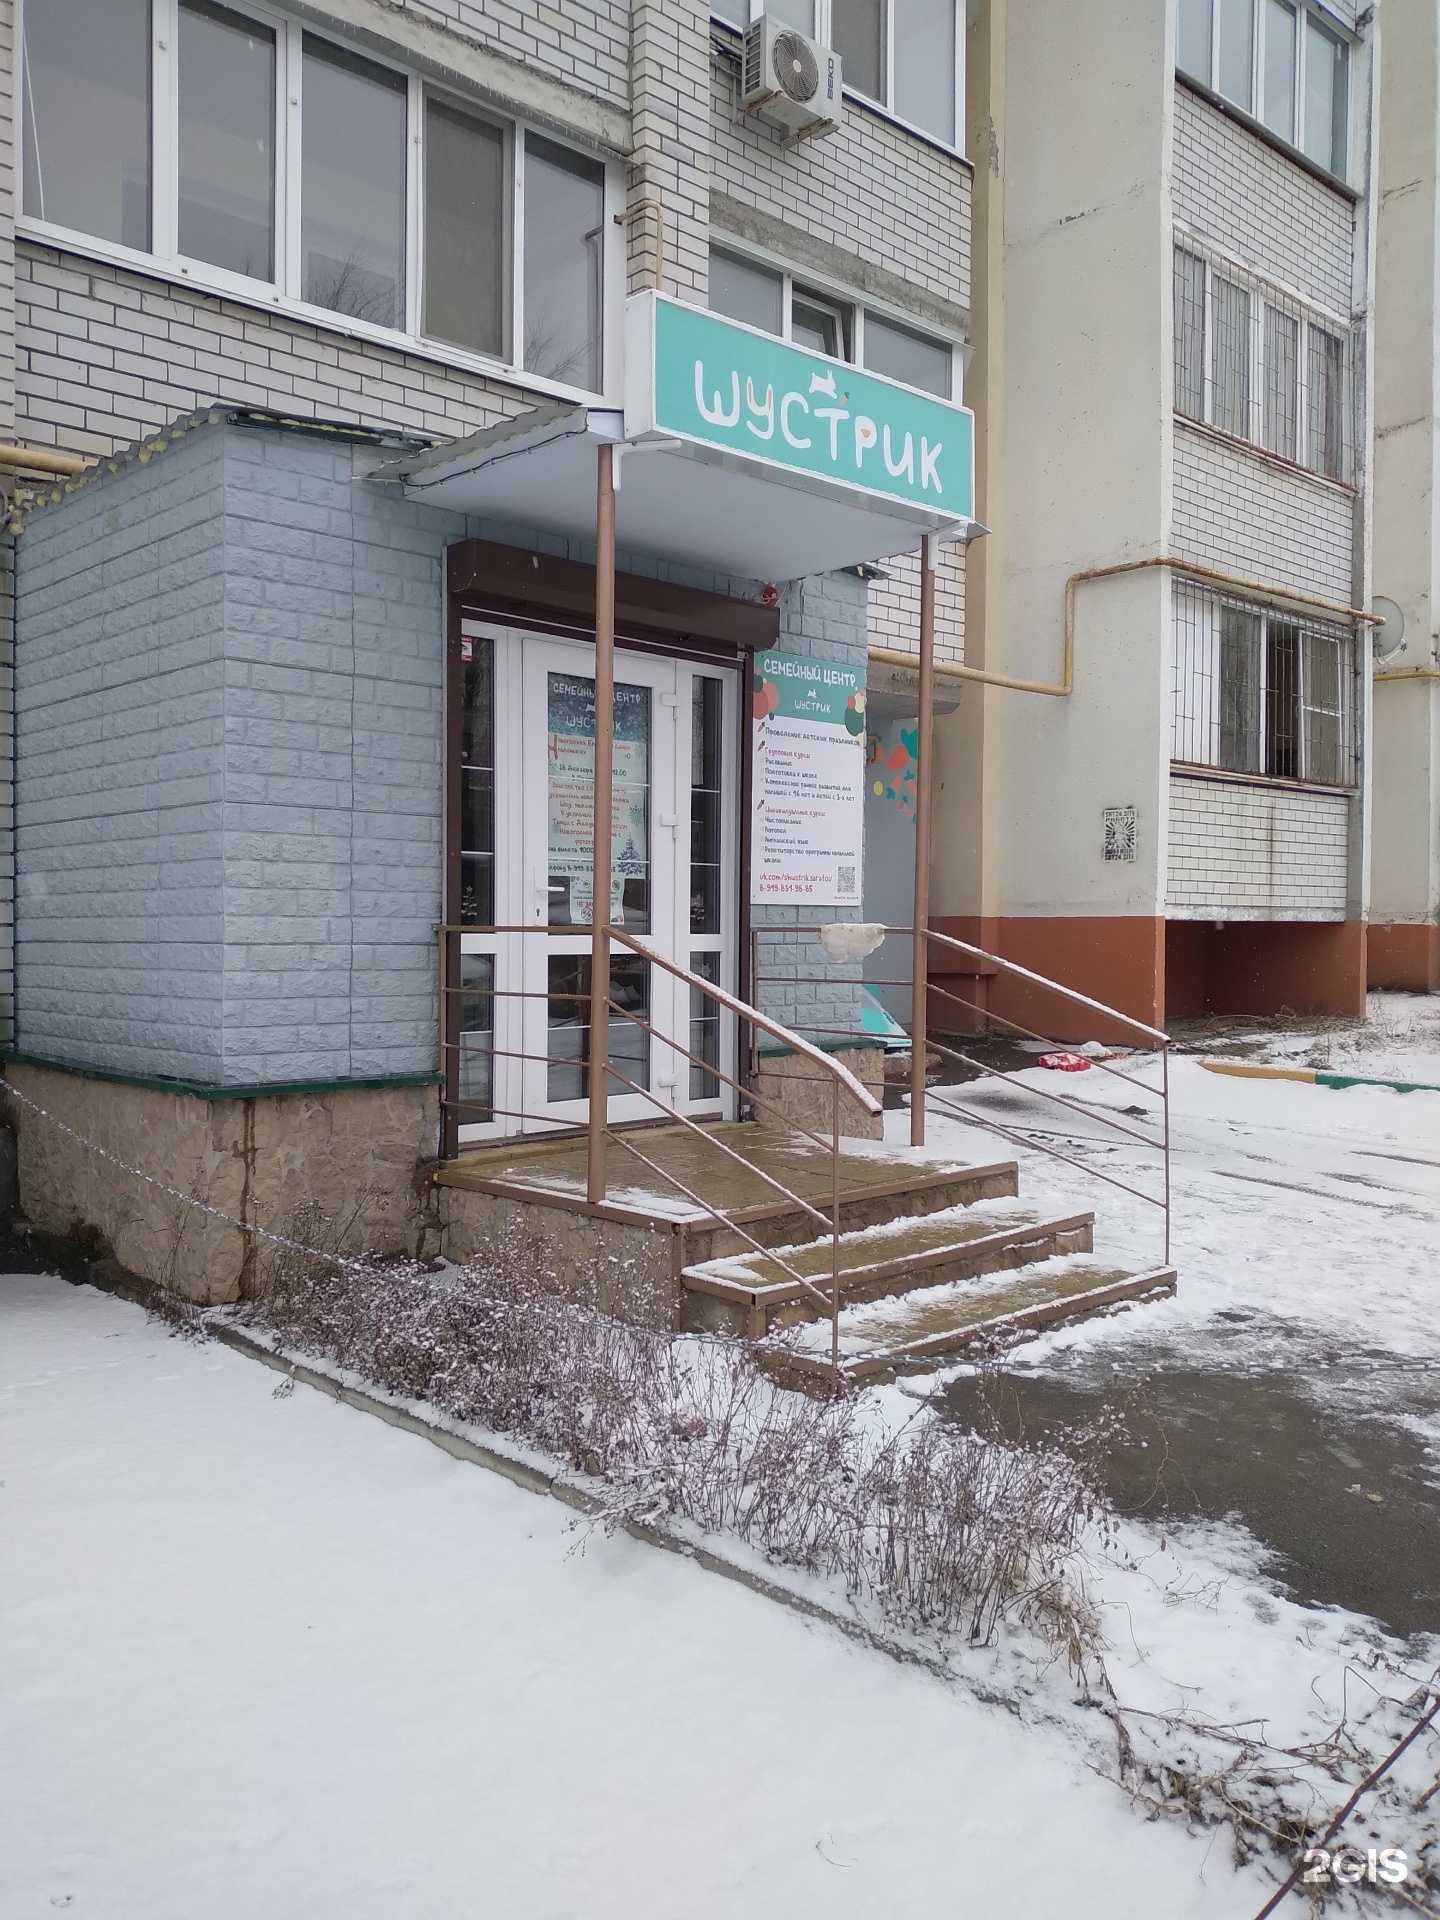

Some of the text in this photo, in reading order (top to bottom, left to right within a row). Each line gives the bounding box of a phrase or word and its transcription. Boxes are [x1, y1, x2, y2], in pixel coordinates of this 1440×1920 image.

[827, 57, 835, 100] BEKO
[694, 360, 943, 493] ШУСТРИК
[763, 659, 856, 687] СЕМЕЙНЫЙ ЦЕНТР
[553, 683, 595, 698] СЕМЕЙНЫ
[794, 699, 831, 713] ШУСТРИК
